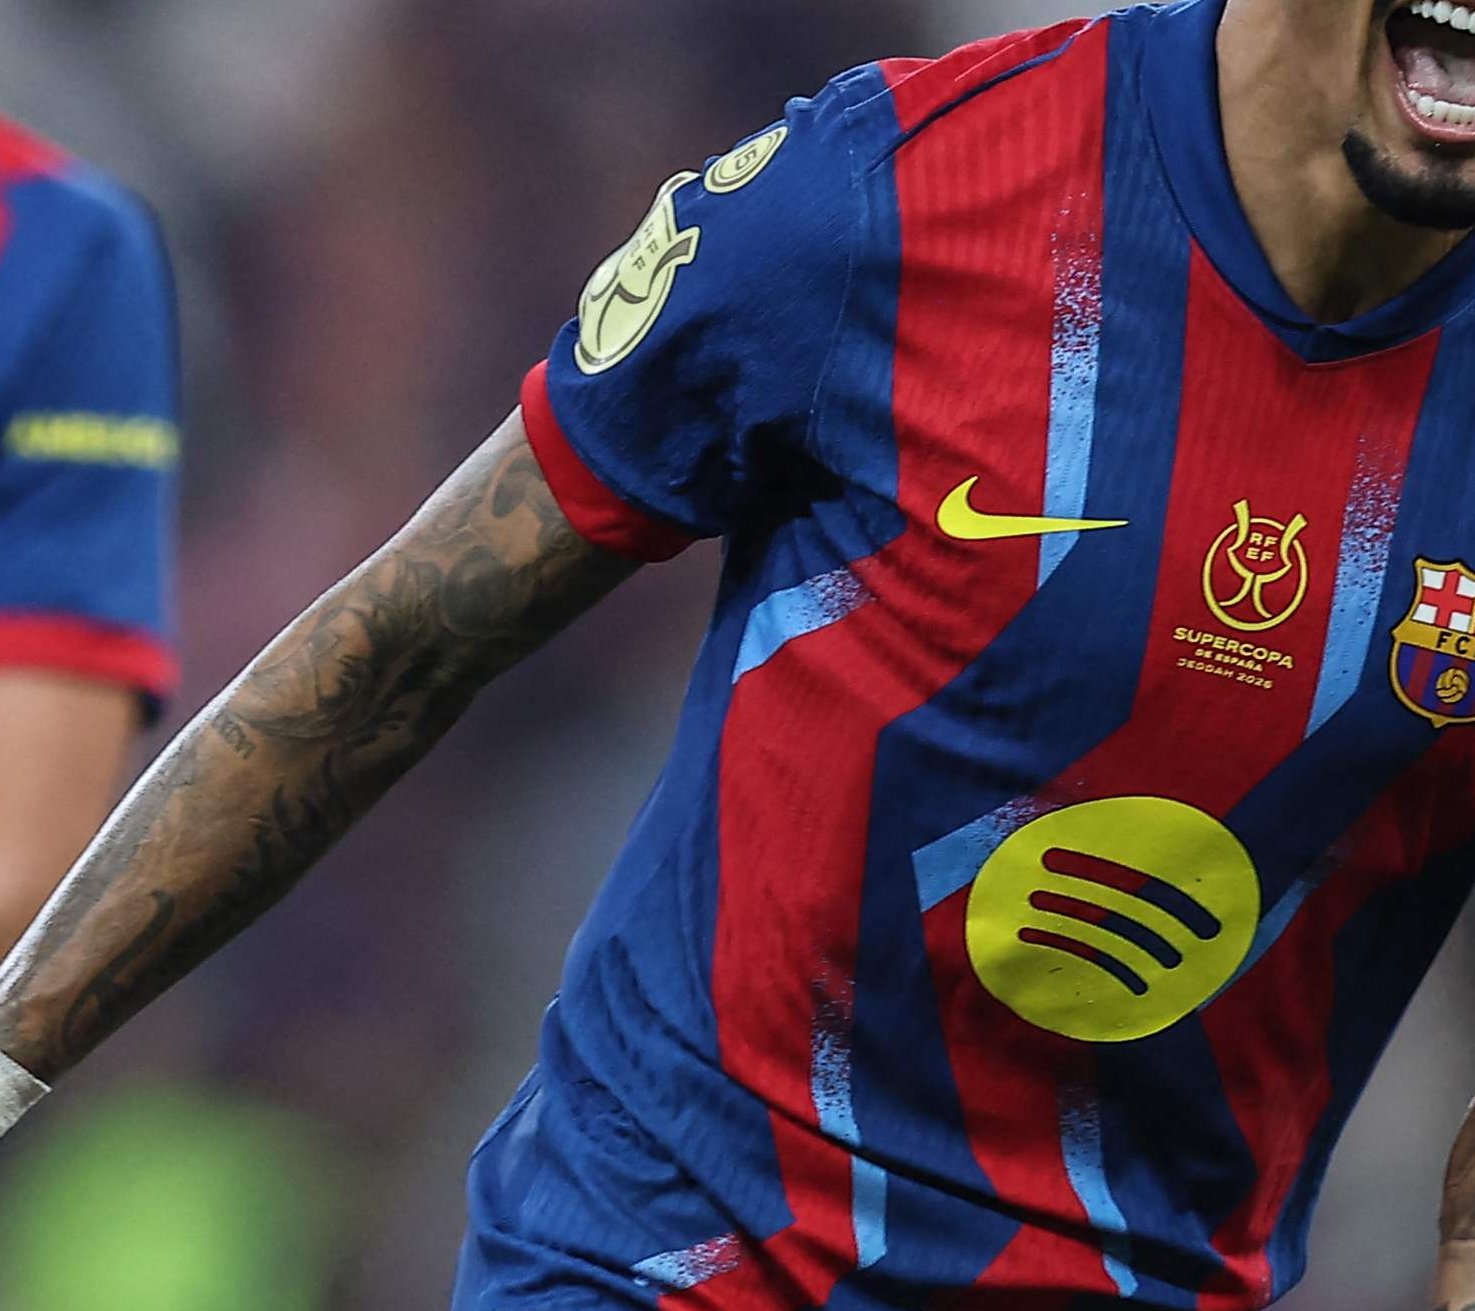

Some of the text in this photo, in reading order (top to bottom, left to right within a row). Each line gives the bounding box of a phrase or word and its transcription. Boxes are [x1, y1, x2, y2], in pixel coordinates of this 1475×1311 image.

[1250, 532, 1279, 548] RF
[1245, 547, 1275, 562] EF
[1173, 627, 1294, 669] SUPERCOPA
[1194, 648, 1213, 660] DE
[1176, 657, 1274, 690] JEDDAH 2026
